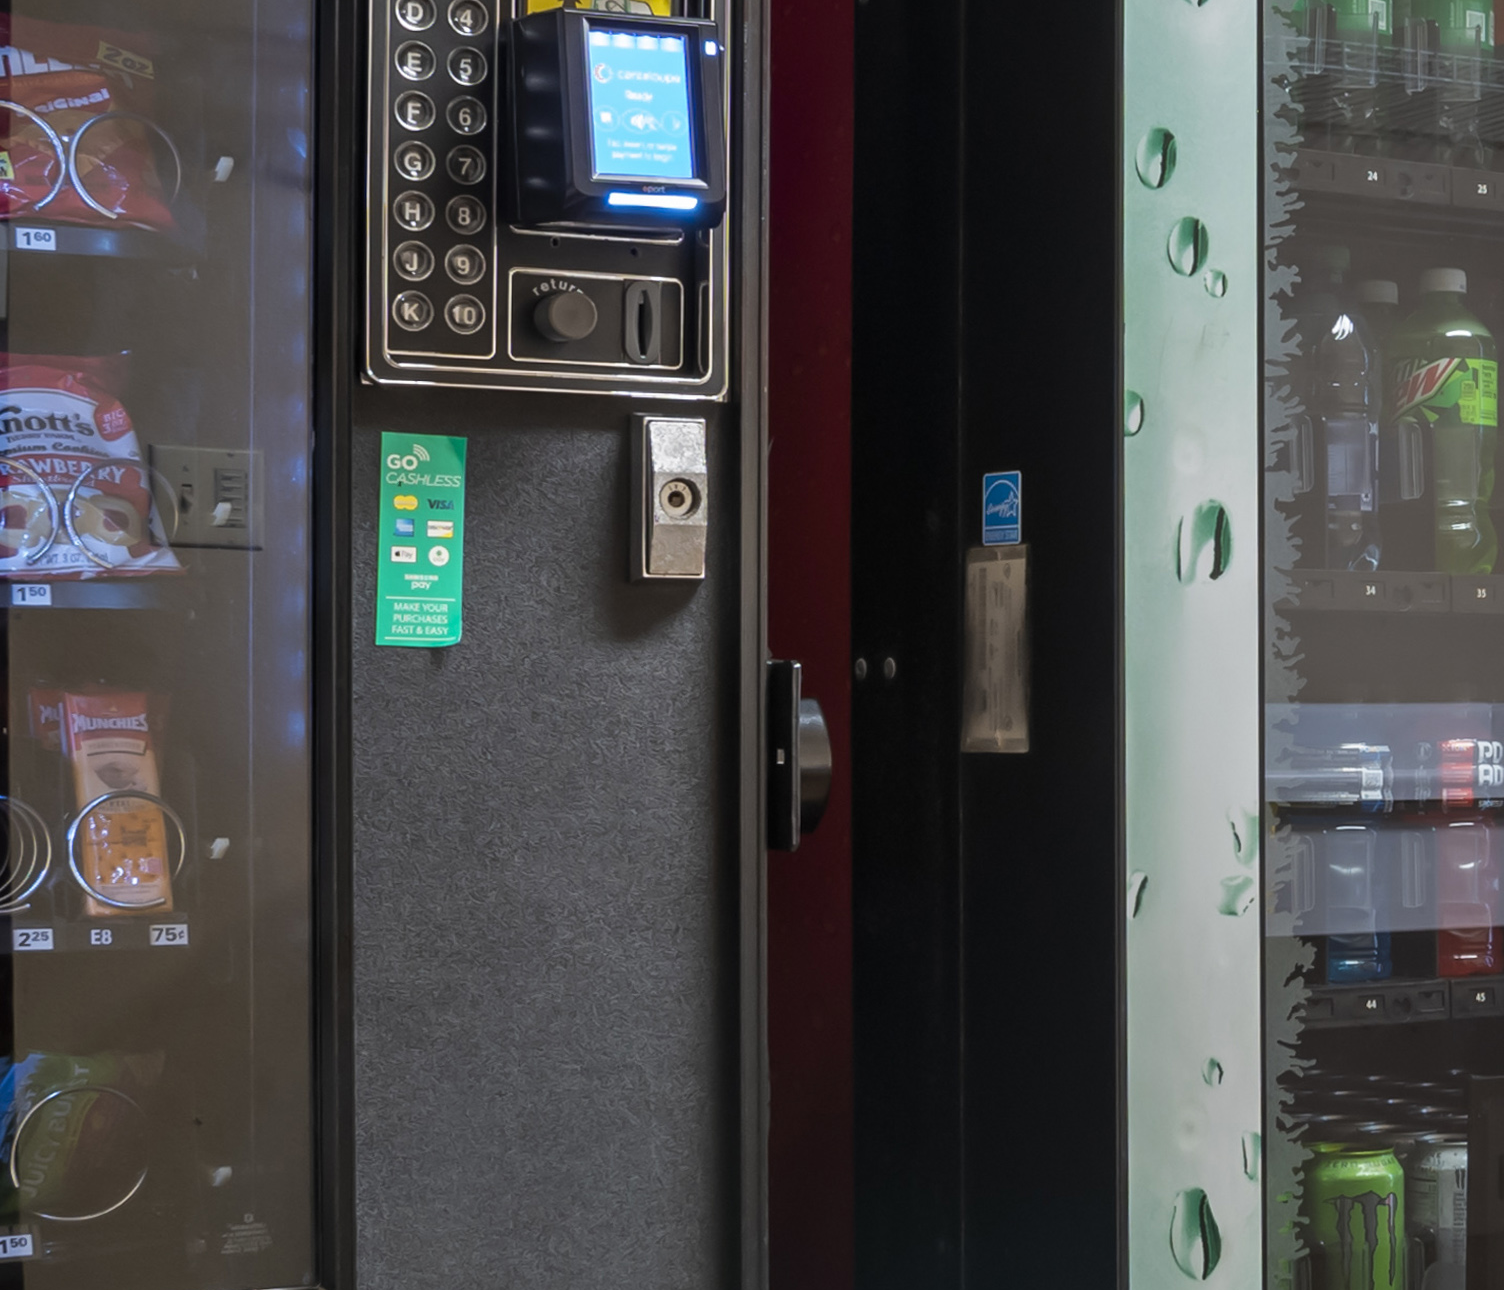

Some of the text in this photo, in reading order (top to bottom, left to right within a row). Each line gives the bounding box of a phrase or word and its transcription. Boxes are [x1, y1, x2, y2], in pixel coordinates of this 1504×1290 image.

[407, 2, 424, 22] D
[459, 9, 474, 28] 4
[407, 51, 422, 72] E
[459, 57, 472, 76] 5
[406, 102, 421, 122] F
[458, 108, 471, 126] 6
[404, 151, 422, 171] G
[458, 157, 472, 175] 7
[1366, 170, 1379, 182] 24
[404, 201, 421, 222] H
[457, 207, 471, 225] 8
[405, 251, 418, 271] J
[456, 256, 470, 276] 9
[403, 302, 419, 322] K
[453, 305, 476, 323] 10
[386, 453, 419, 471] GO
[385, 471, 462, 488] CASHLESS
[426, 497, 456, 511] VISA
[411, 581, 433, 591] pay
[392, 602, 450, 614] MAKE YOUR
[392, 613, 449, 625] PURCHASES
[391, 624, 450, 636] FAST EASY
[72, 712, 149, 733] MUNCHIES
[90, 928, 113, 946] E8
[1475, 992, 1486, 1003] 45
